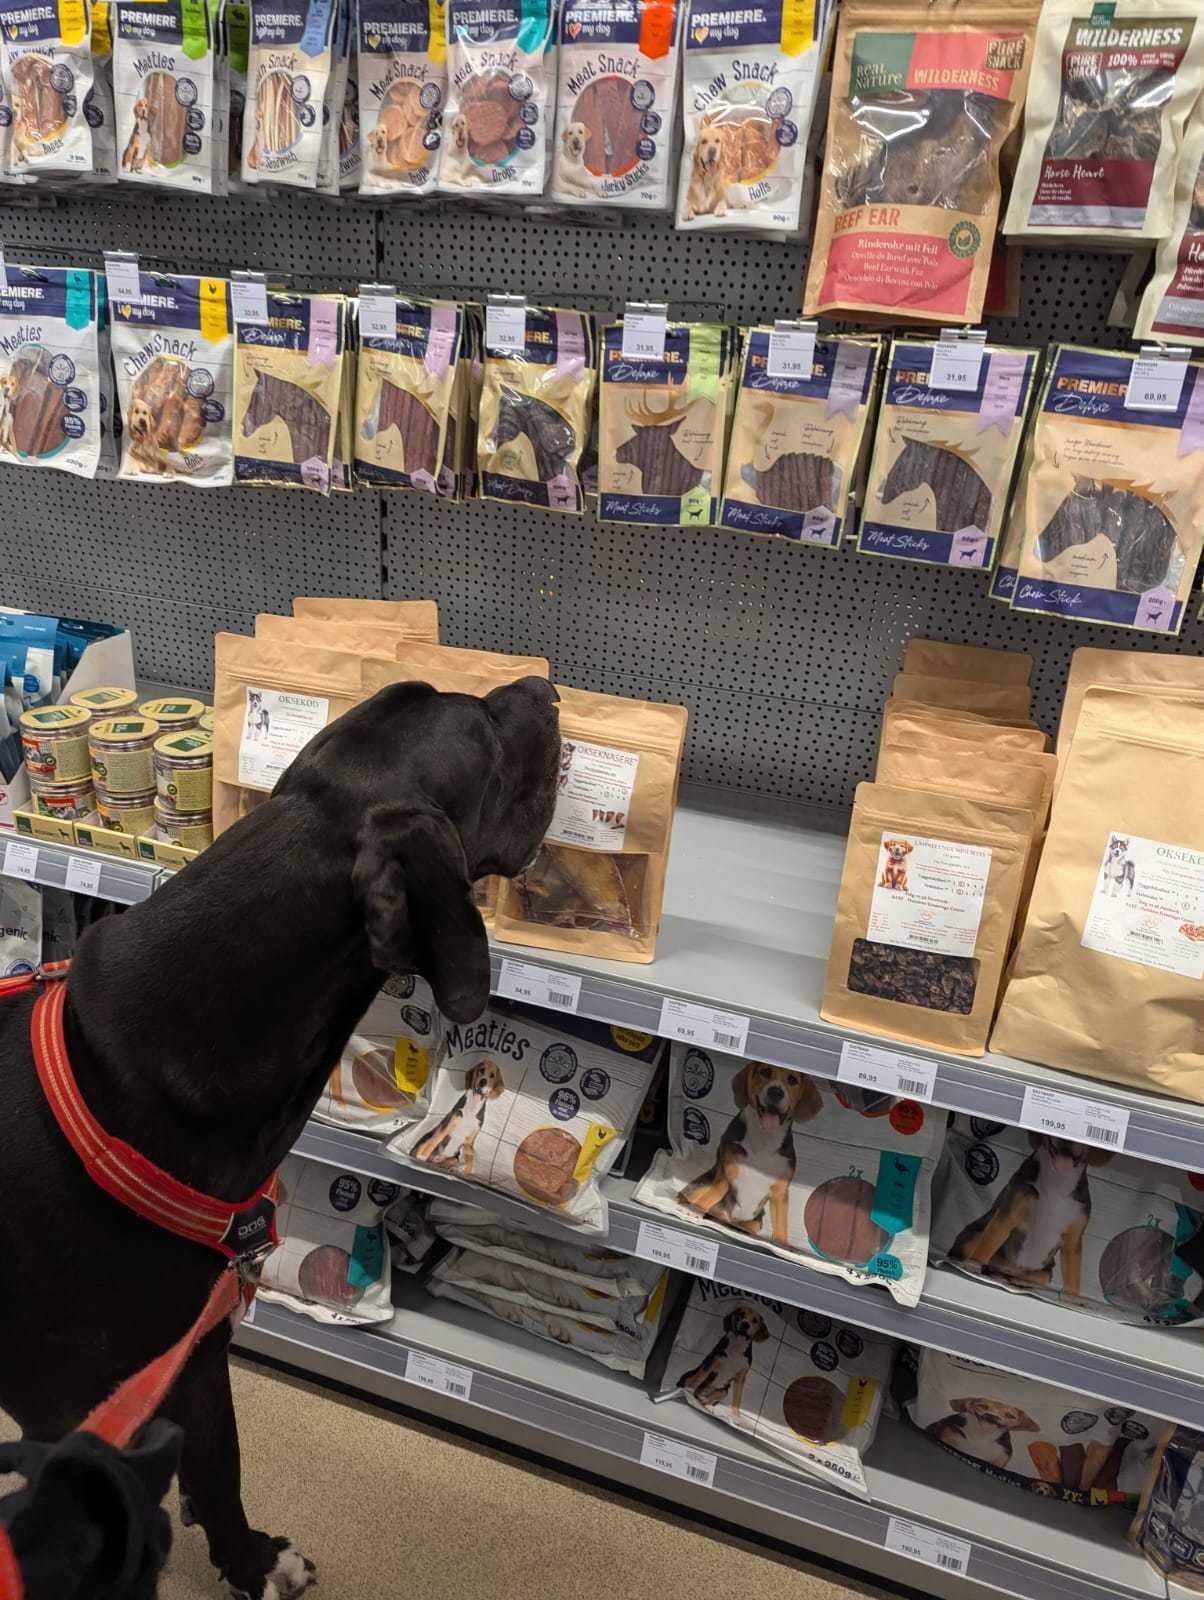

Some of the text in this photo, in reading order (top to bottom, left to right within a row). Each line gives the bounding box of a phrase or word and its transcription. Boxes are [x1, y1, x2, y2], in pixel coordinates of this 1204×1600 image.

[255, 14, 304, 27] PREMIERE.
[453, 9, 519, 24] PREMIERE.
[565, 9, 638, 24] PREMIERE.
[691, 9, 767, 26] PREMIERE.
[363, 22, 427, 36] PREMIERE.
[582, 23, 595, 34] my
[595, 22, 611, 36] dog
[710, 27, 723, 40] my
[723, 26, 739, 39] dog
[1075, 28, 1183, 47] WILDERNESS
[988, 39, 1024, 56] PURE
[133, 53, 176, 77] Meaties
[480, 51, 518, 71] Snack
[987, 55, 1022, 69] SNACK
[1070, 54, 1097, 66] PURE
[1108, 53, 1137, 68] 100%
[394, 63, 428, 81] Snack
[567, 54, 640, 95] Meat Snack
[914, 68, 999, 91] WILDERNESS
[1068, 65, 1096, 80] SNACK
[694, 60, 779, 111] Chew Snack
[1044, 164, 1104, 180] Horse Heart
[834, 207, 900, 233] BEEF EAR
[858, 238, 904, 250] Rinderohr
[905, 243, 920, 252] mit
[142, 294, 179, 309] MIERE.
[0, 325, 42, 356] Meaties
[124, 334, 197, 377] Chew Snack
[892, 386, 949, 404] Deluxe
[1057, 376, 1128, 397] PREMIER
[1052, 392, 1112, 414] Deluxe
[446, 1018, 531, 1061] Meaties
[1041, 1118, 1066, 1130] 199,95
[338, 1177, 359, 1192] 95%
[876, 1257, 898, 1269] 95%
